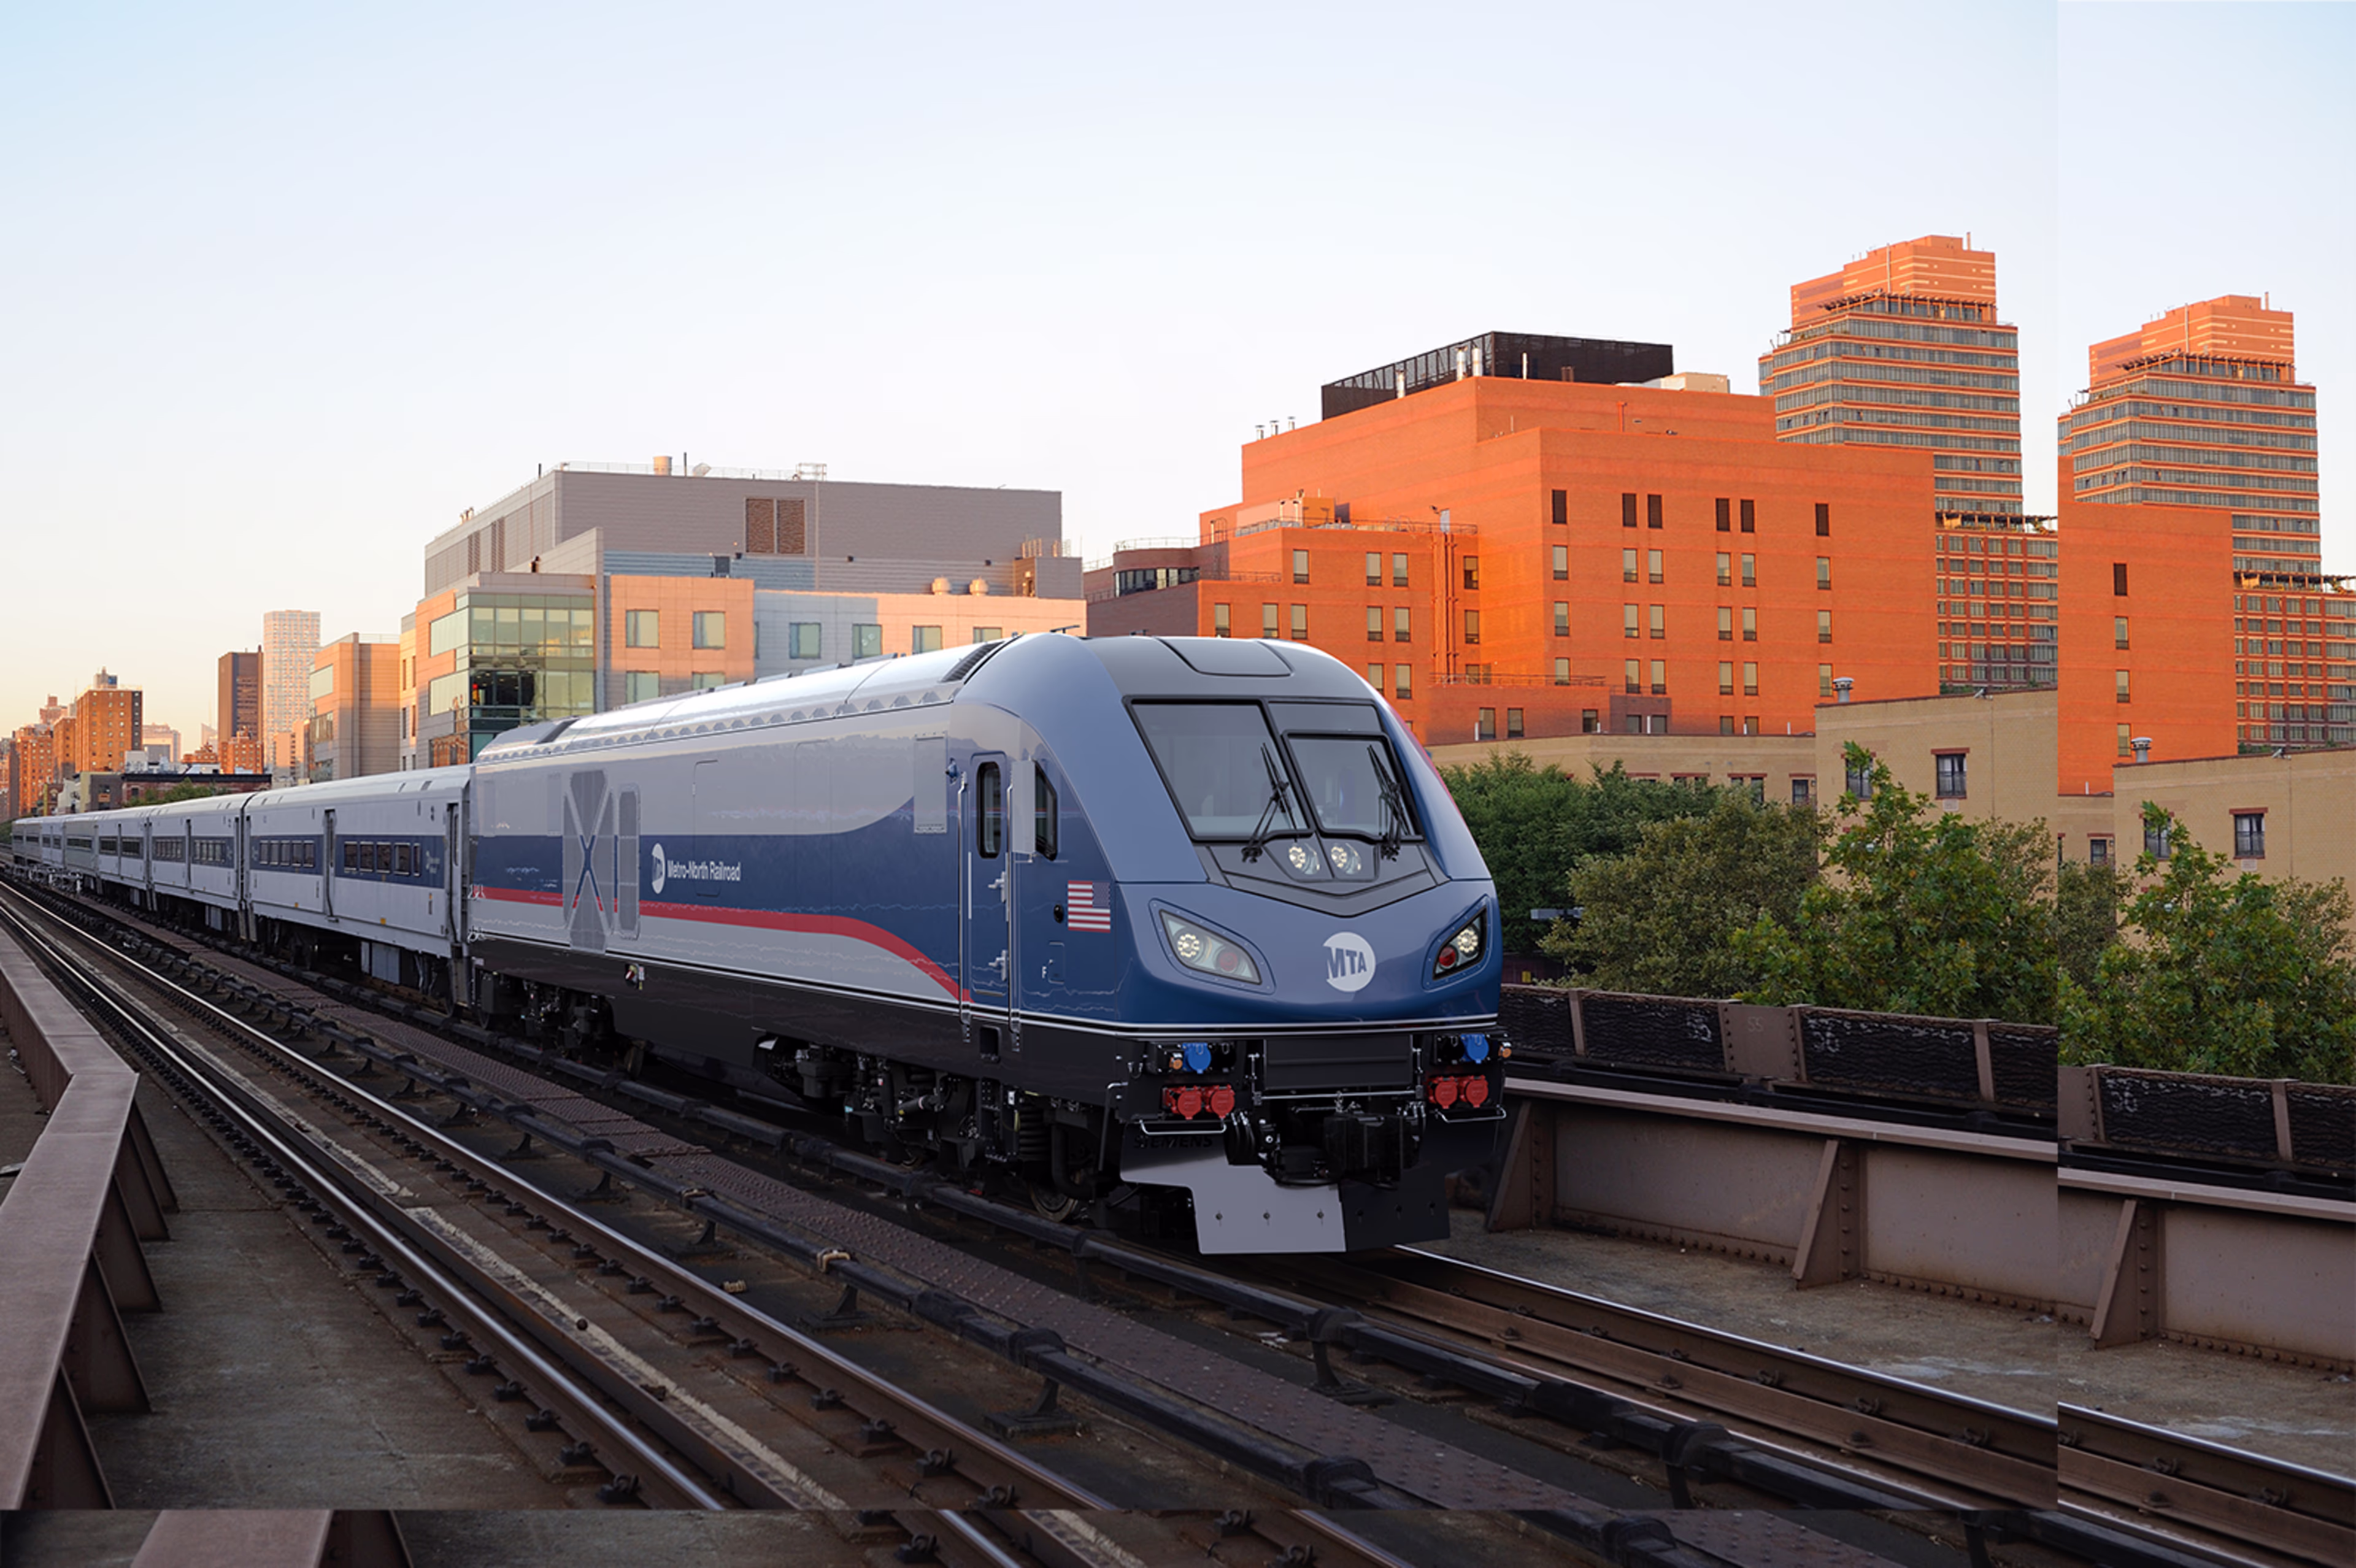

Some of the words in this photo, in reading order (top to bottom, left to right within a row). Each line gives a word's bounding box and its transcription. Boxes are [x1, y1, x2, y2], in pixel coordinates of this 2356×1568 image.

[667, 859, 709, 880] Metro-North
[709, 860, 741, 882] Railroad
[1324, 945, 1368, 980] MTA
